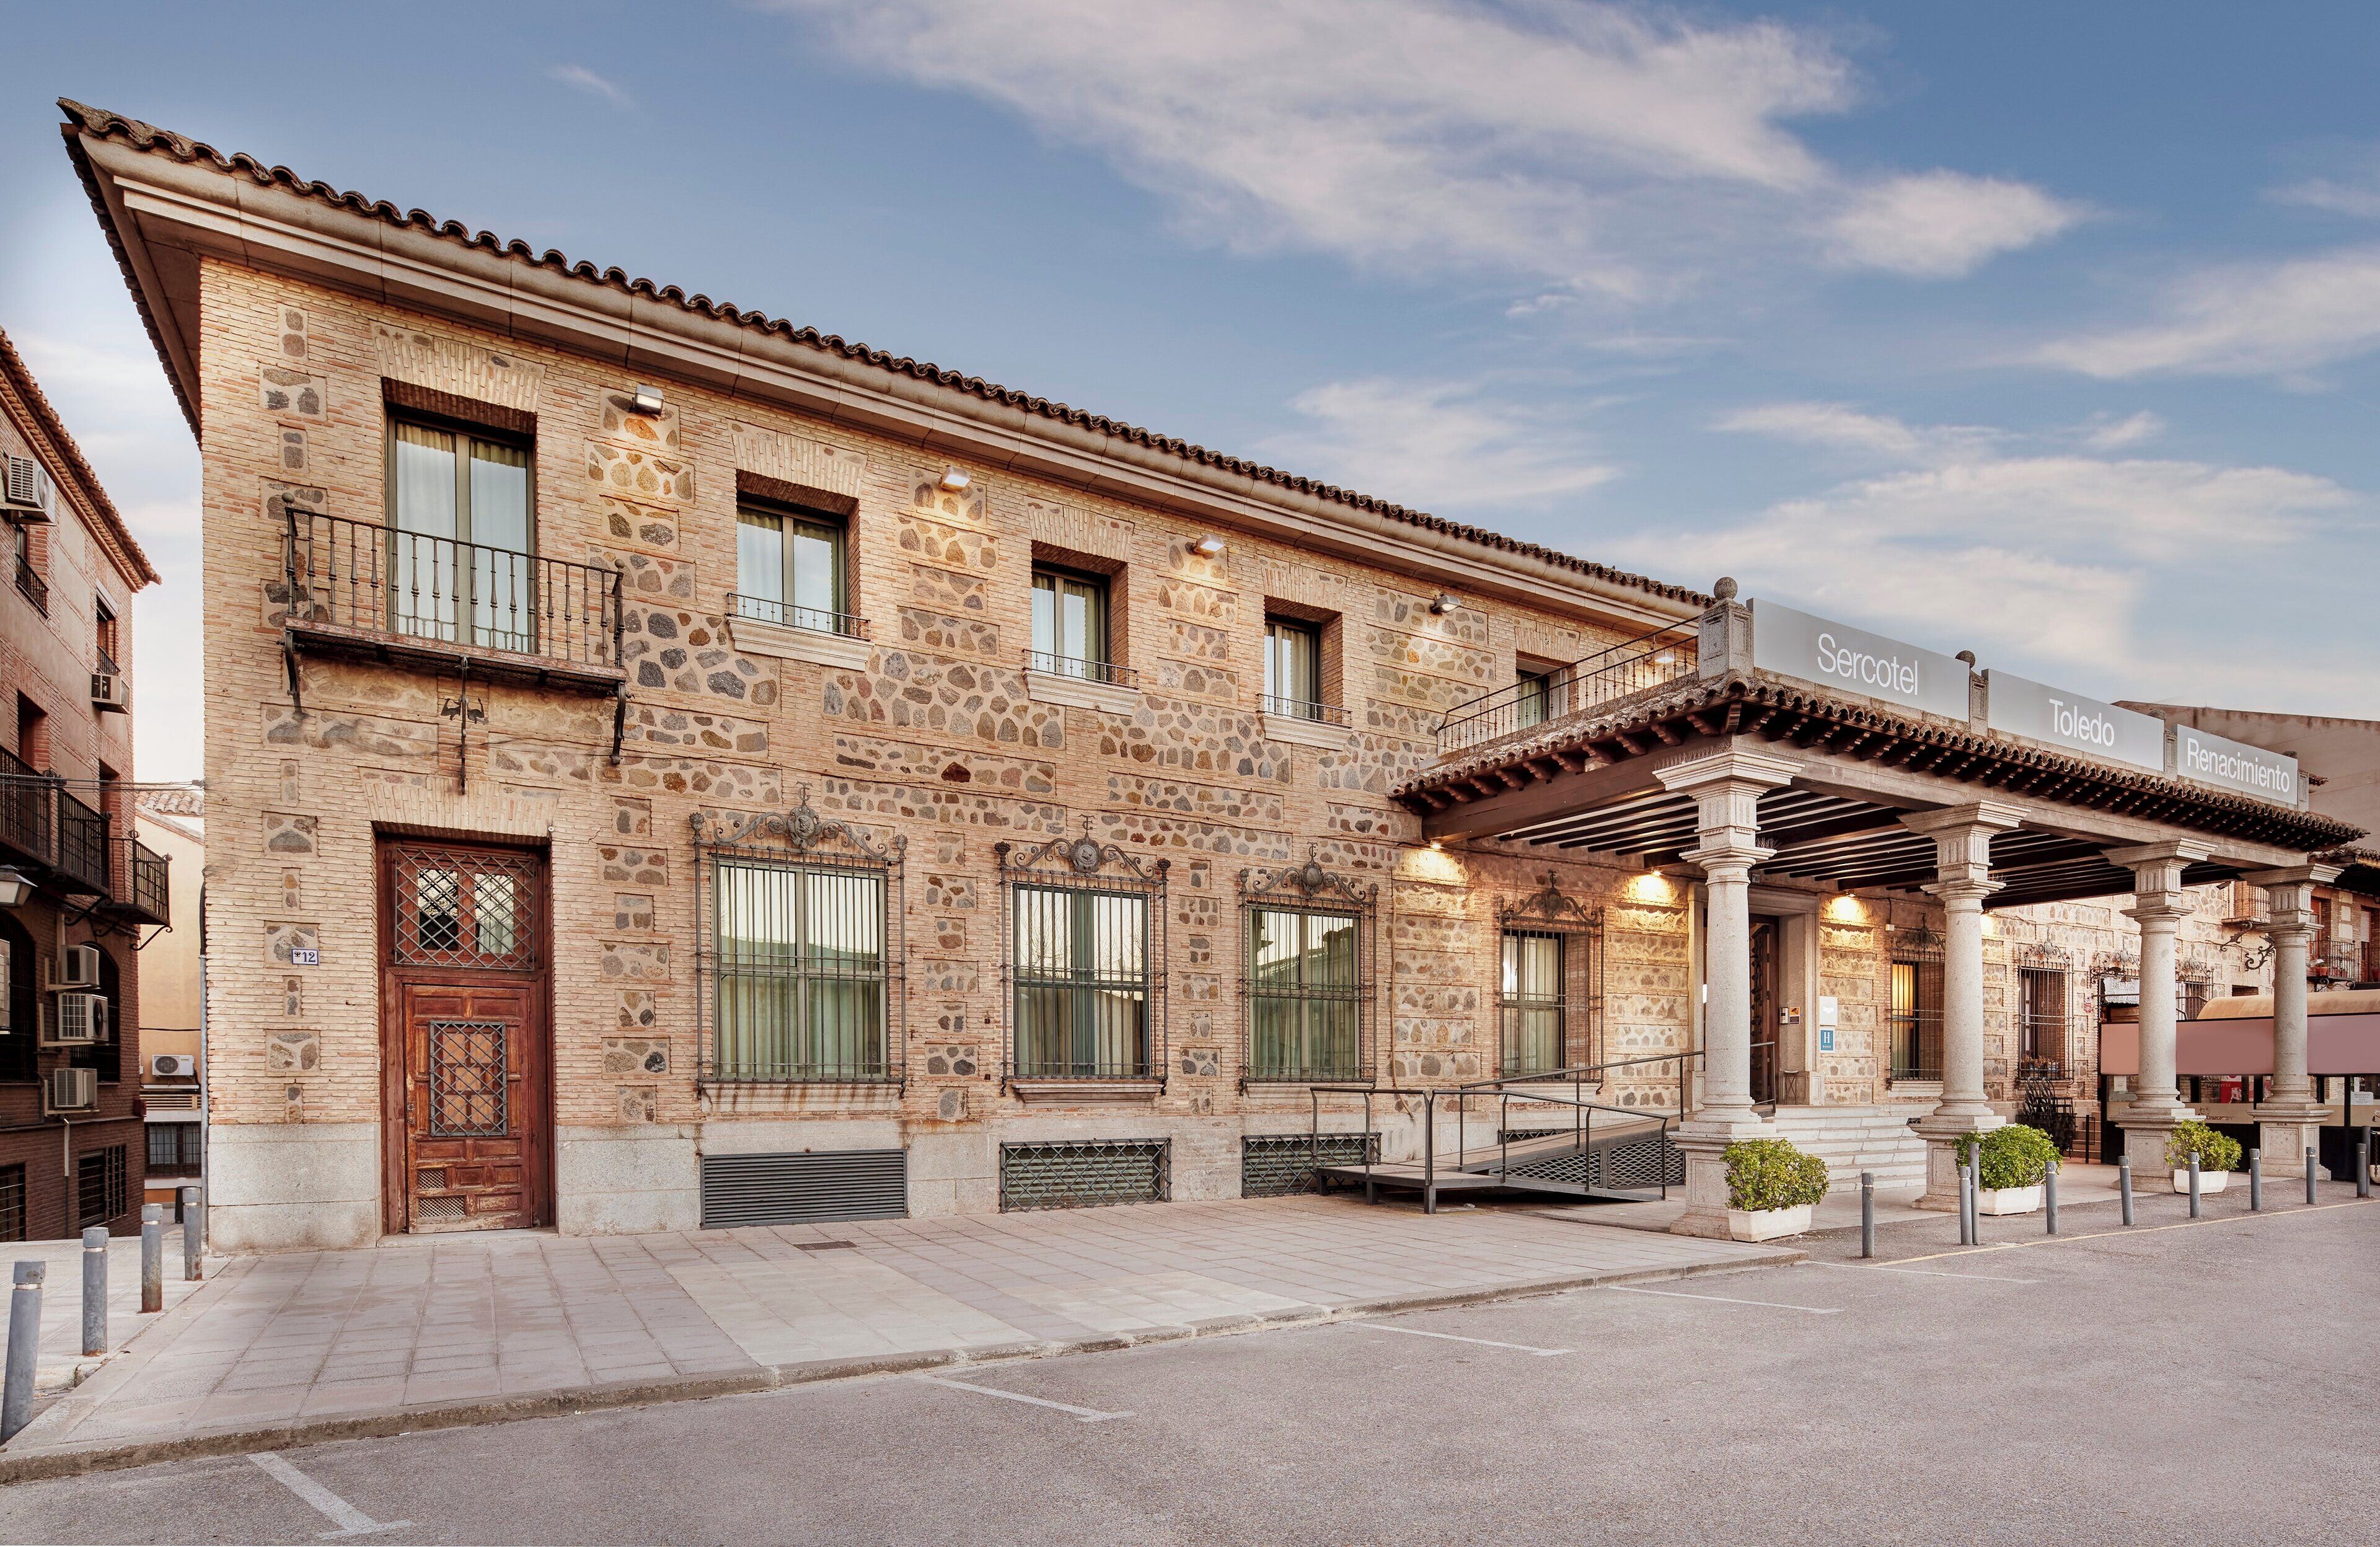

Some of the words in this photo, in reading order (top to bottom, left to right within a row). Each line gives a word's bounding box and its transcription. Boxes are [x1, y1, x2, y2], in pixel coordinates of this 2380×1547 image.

[1817, 633, 1918, 695] Sercotel
[2049, 698, 2114, 747] Toledo
[2187, 738, 2290, 793] Renacimiento
[302, 951, 315, 962] 12
[1823, 1032, 1830, 1043] H
